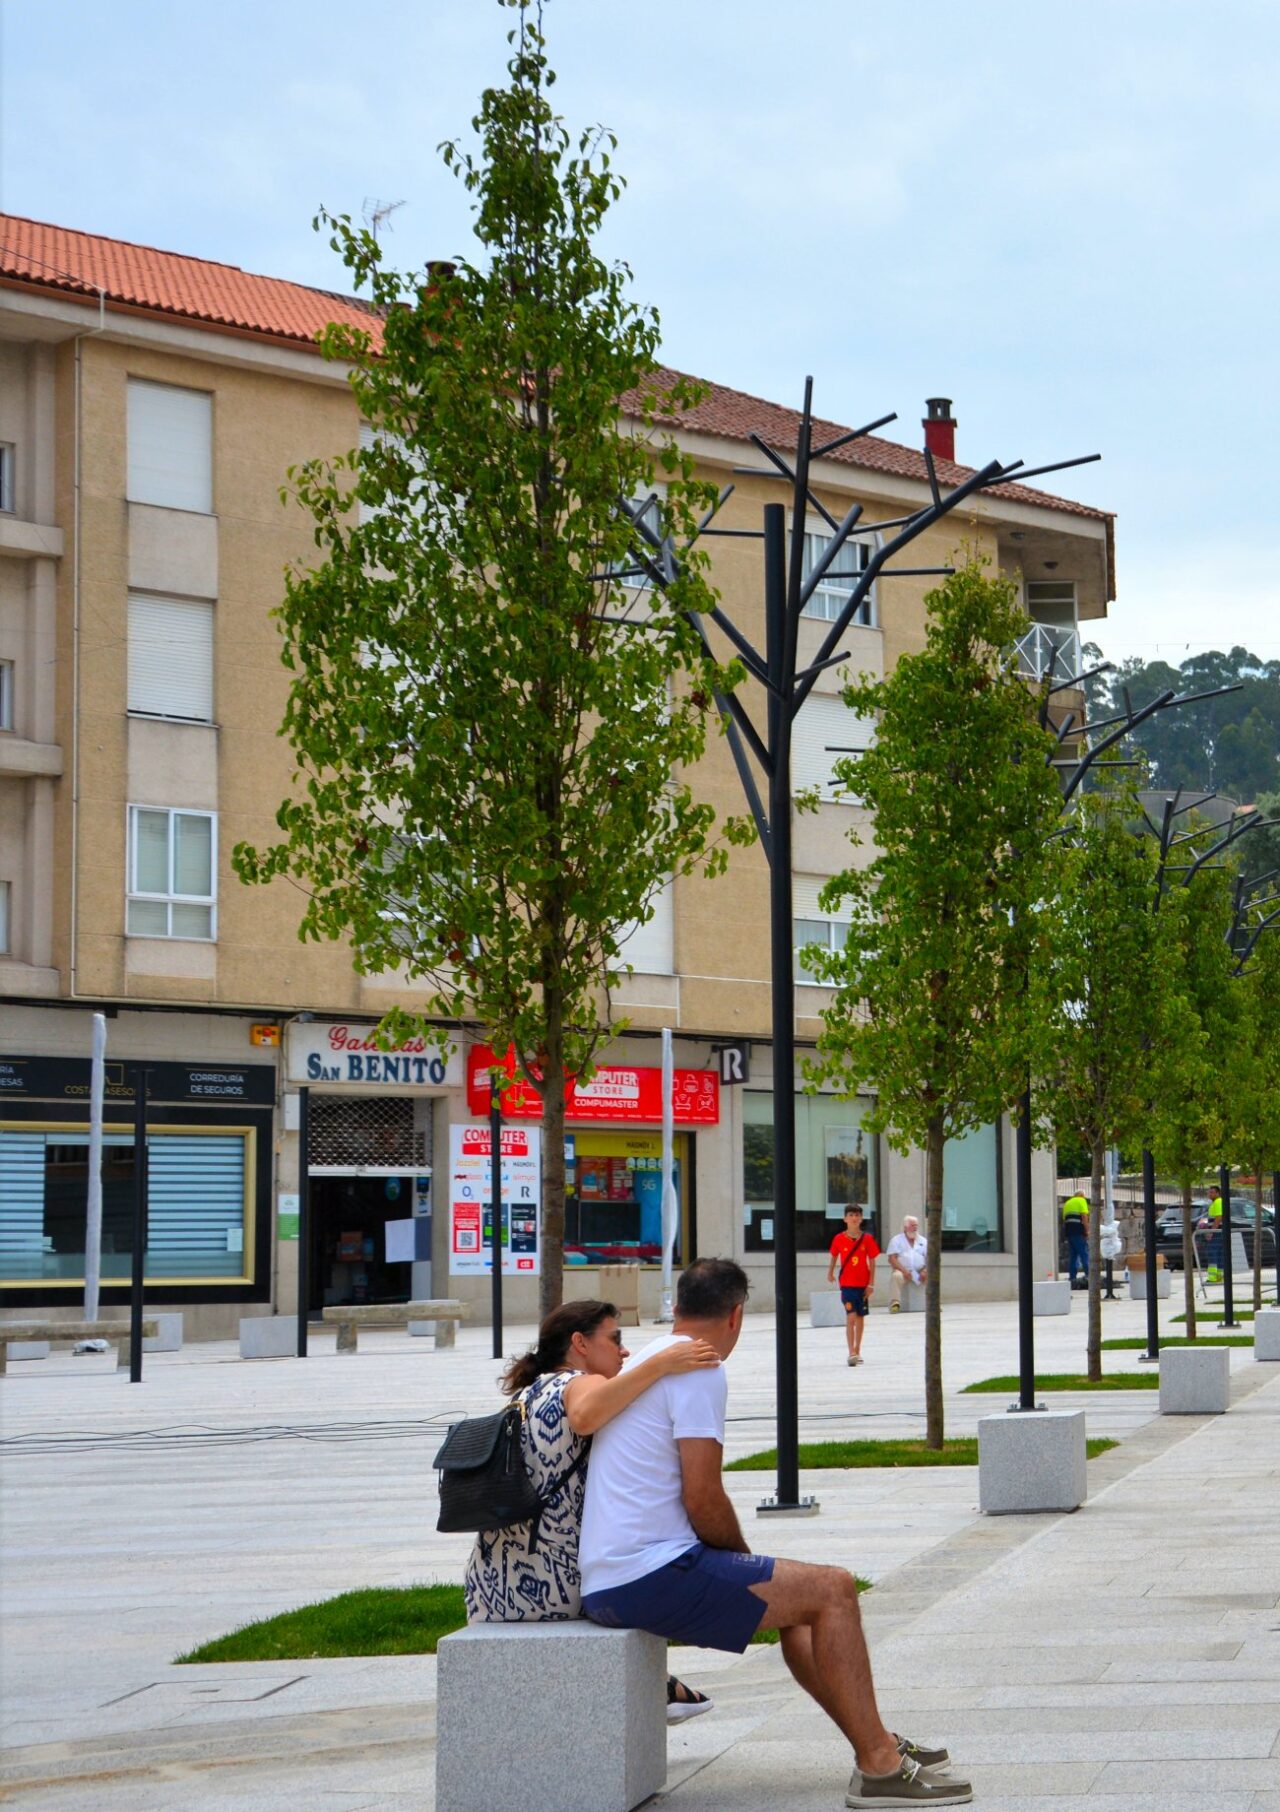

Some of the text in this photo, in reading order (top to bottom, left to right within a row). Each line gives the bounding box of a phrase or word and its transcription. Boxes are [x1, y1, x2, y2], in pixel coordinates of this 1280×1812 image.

[347, 1055, 446, 1084] BENITO
[723, 1048, 743, 1081] R
[189, 1073, 244, 1083] CORREDURÍA
[64, 1085, 152, 1097] COST ASESOS
[190, 1085, 244, 1095] DE SEGUROS
[592, 1086, 624, 1095] STORE
[574, 1098, 638, 1109] COMPUMASTER
[464, 1129, 526, 1143] COMUTER
[480, 1144, 513, 1153] STRE
[521, 1186, 531, 1198] R
[851, 1256, 859, 1266] 9
